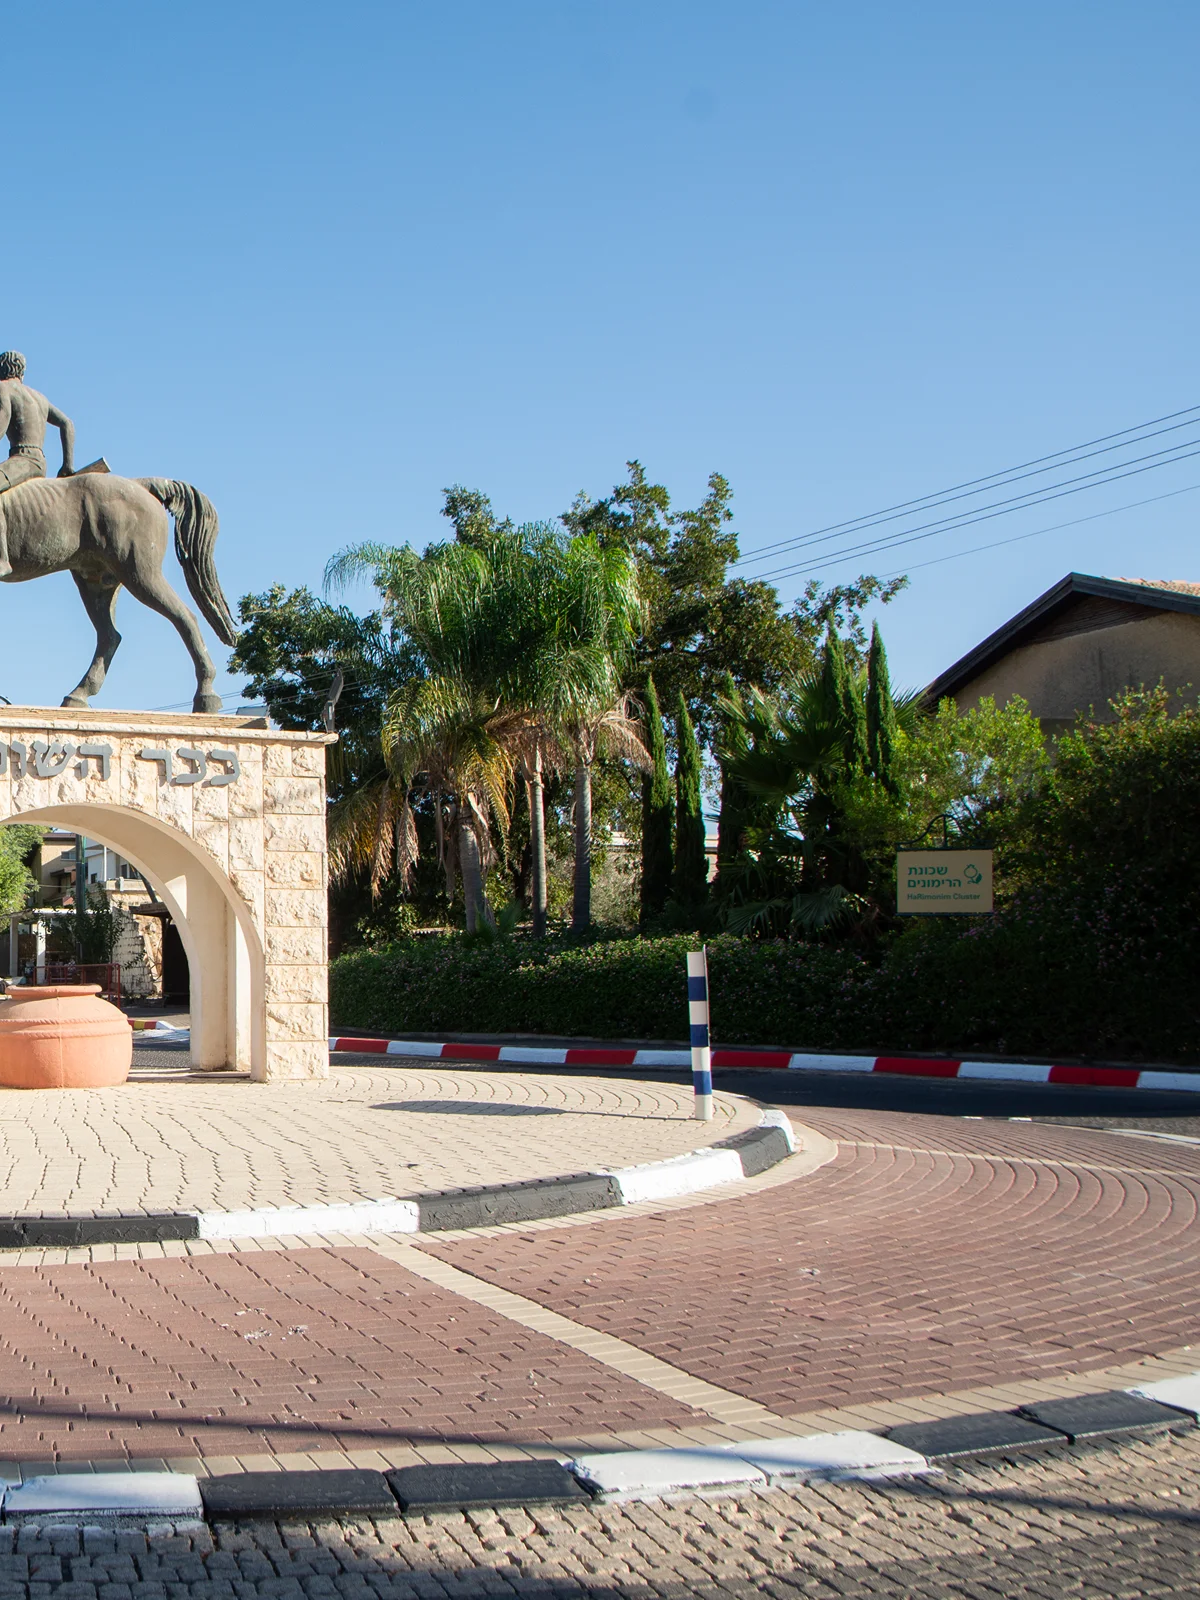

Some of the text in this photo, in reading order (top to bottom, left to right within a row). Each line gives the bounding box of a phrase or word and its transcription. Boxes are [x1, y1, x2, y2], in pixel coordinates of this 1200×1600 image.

[139, 747, 242, 786] ככר
[908, 866, 949, 876] שכונת
[907, 879, 962, 889] הרימונים
[907, 893, 981, 901] HaRimonim Cluster
